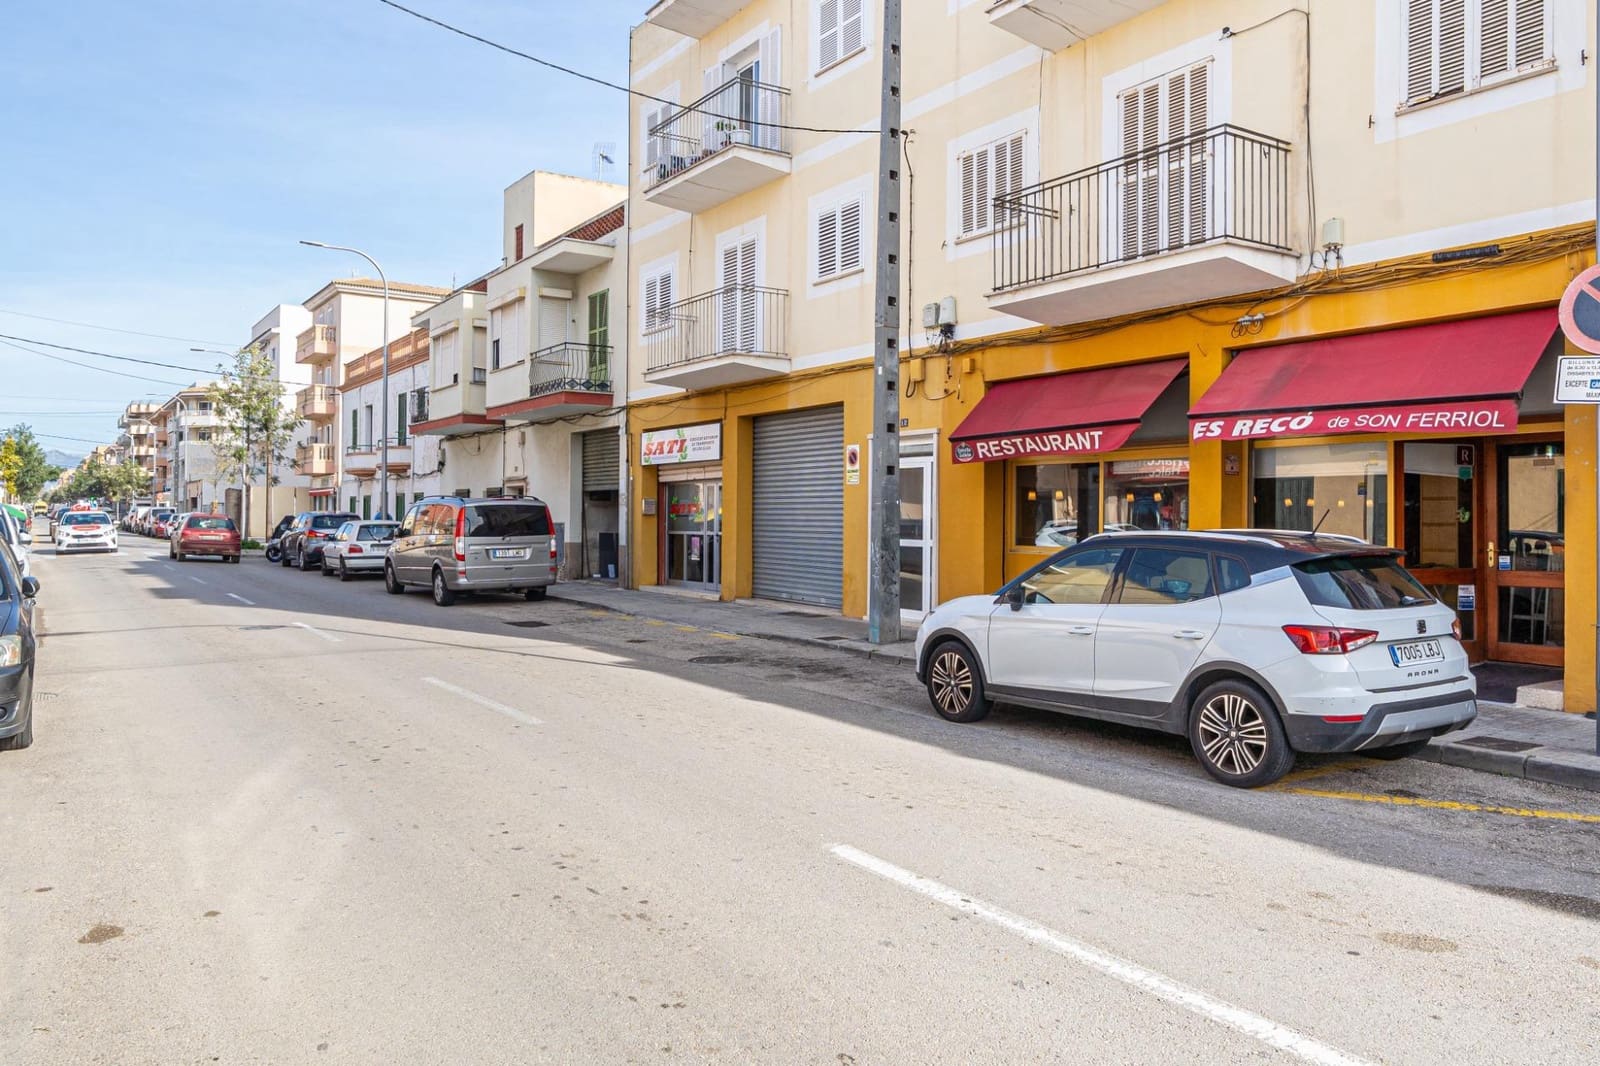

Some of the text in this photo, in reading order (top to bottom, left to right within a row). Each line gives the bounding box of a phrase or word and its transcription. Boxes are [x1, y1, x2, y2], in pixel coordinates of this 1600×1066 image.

[1565, 380, 1588, 388] EXCEPTE
[1192, 420, 1225, 441] ES
[1327, 415, 1350, 429] de
[1354, 414, 1402, 428] SON
[1405, 410, 1506, 428] FERRIOL
[643, 439, 687, 457] SATI
[975, 430, 1103, 460] RESTAURANT
[1461, 448, 1469, 461] R
[1397, 641, 1441, 661] 7005 LBJ
[1407, 668, 1440, 677] ARONA
